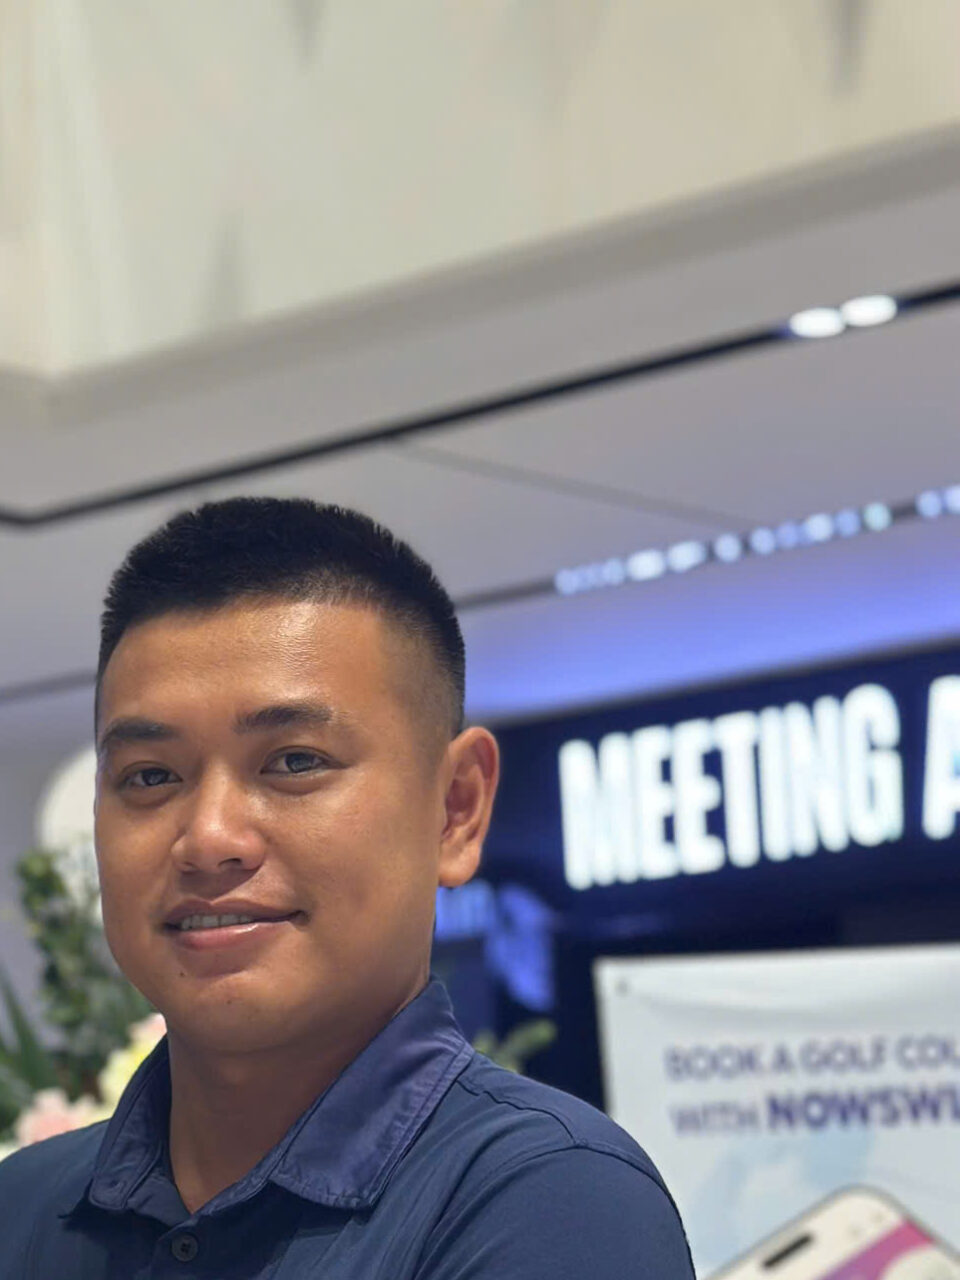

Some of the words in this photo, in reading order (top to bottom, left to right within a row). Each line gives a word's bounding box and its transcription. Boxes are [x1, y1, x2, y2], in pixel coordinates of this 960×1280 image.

[558, 682, 904, 891] MEETING
[665, 1045, 760, 1082] BOOK
[799, 1037, 887, 1073] GOLF
